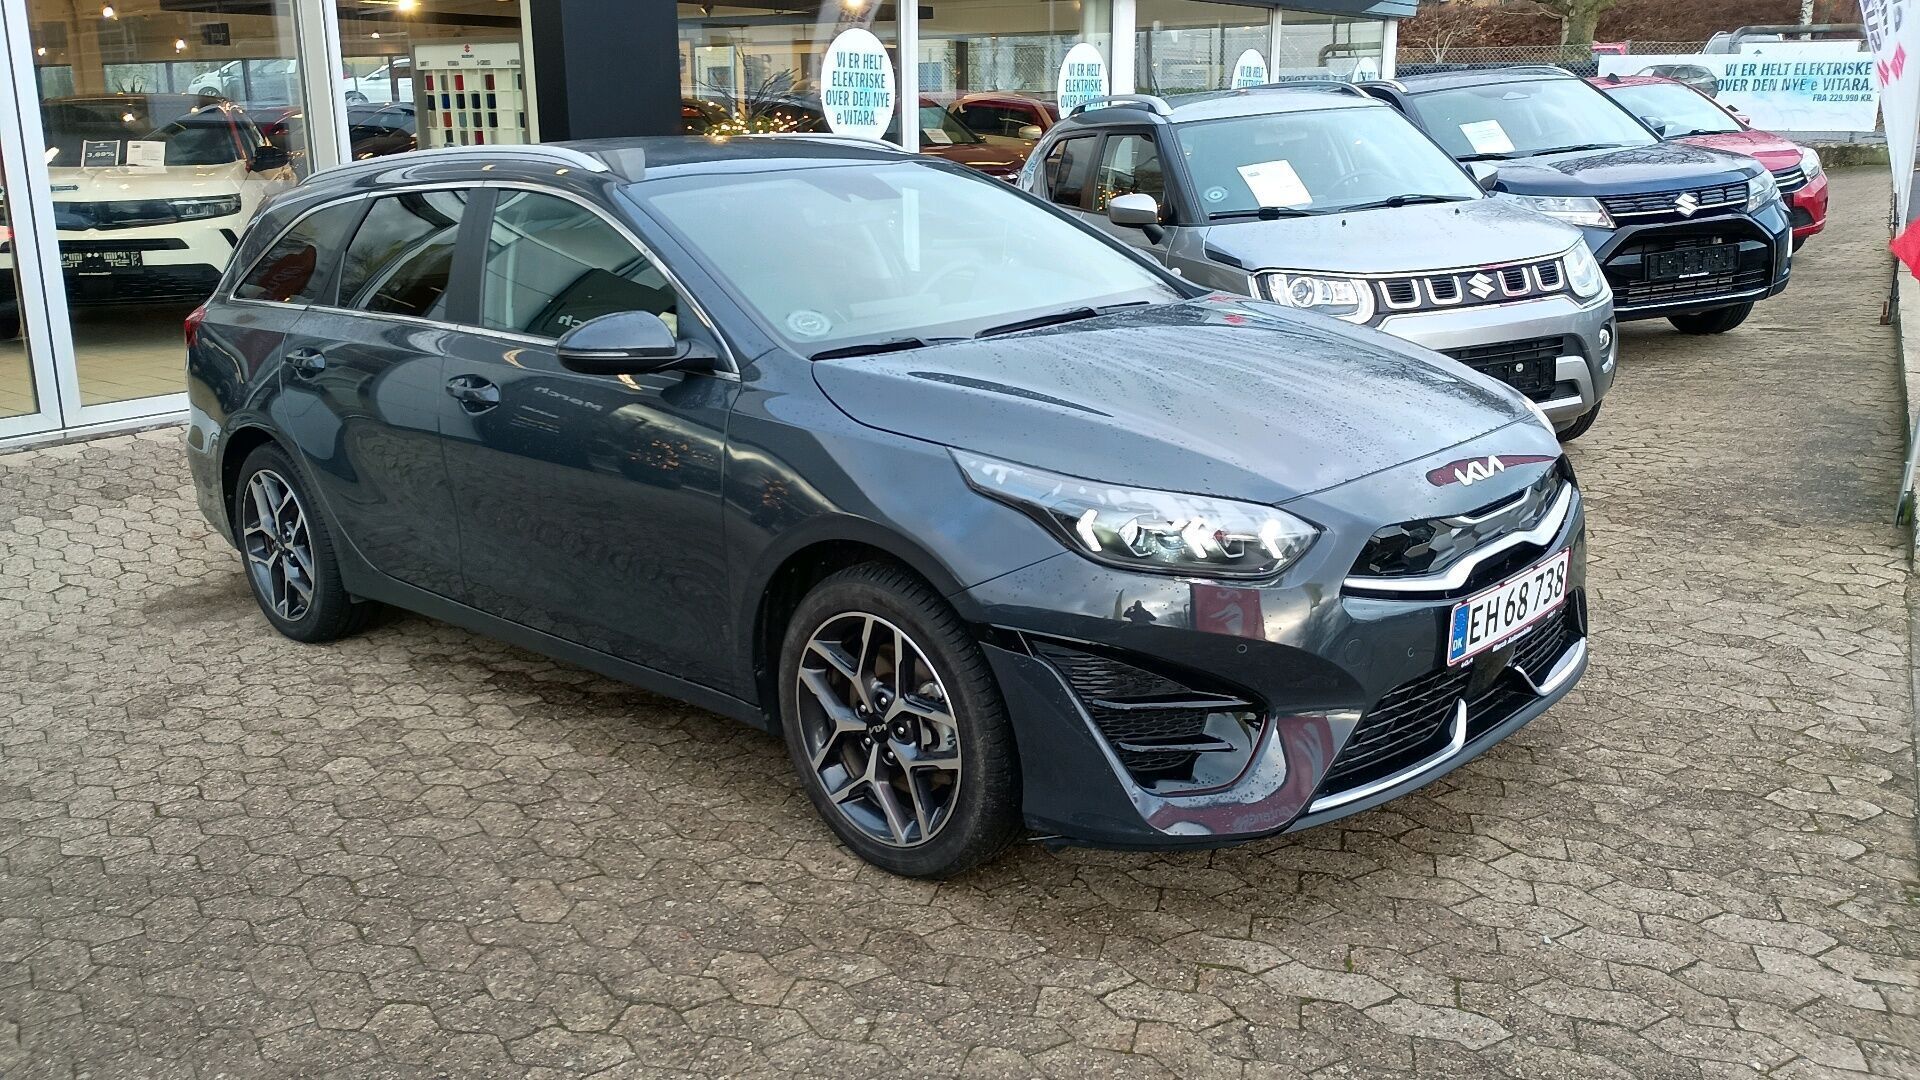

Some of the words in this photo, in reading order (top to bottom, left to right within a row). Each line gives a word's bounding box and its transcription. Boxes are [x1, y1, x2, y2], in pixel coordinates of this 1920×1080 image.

[836, 51, 846, 68] VI
[848, 52, 860, 69] ER
[863, 53, 884, 70] HELT
[1068, 63, 1075, 77] VI
[1077, 63, 1085, 77] ER
[1086, 63, 1101, 77] HELT
[1725, 63, 1738, 77] VI
[1740, 63, 1757, 77] ER
[1760, 62, 1792, 76] HELT
[1793, 61, 1873, 76] ELEKTRISKE
[832, 70, 886, 89] ELEKTRISKE
[1065, 78, 1102, 93] ELEKTRISKE
[1716, 78, 1748, 92] OVER
[1752, 78, 1777, 92] DEN
[1781, 78, 1808, 91] NYE
[1810, 80, 1818, 91] e
[1823, 77, 1874, 92] VITARA.
[825, 89, 849, 106] OVER
[852, 90, 870, 107] DEN
[873, 91, 890, 108] NYE
[1060, 94, 1077, 109] OVER
[1812, 93, 1827, 102] FRA
[836, 112, 842, 125] e
[843, 109, 878, 126] VITARA.
[1454, 454, 1505, 487] KIA
[1469, 596, 1501, 646] EH
[1504, 581, 1529, 627] 68
[1533, 560, 1566, 612] 738
[1452, 637, 1463, 651] DK
